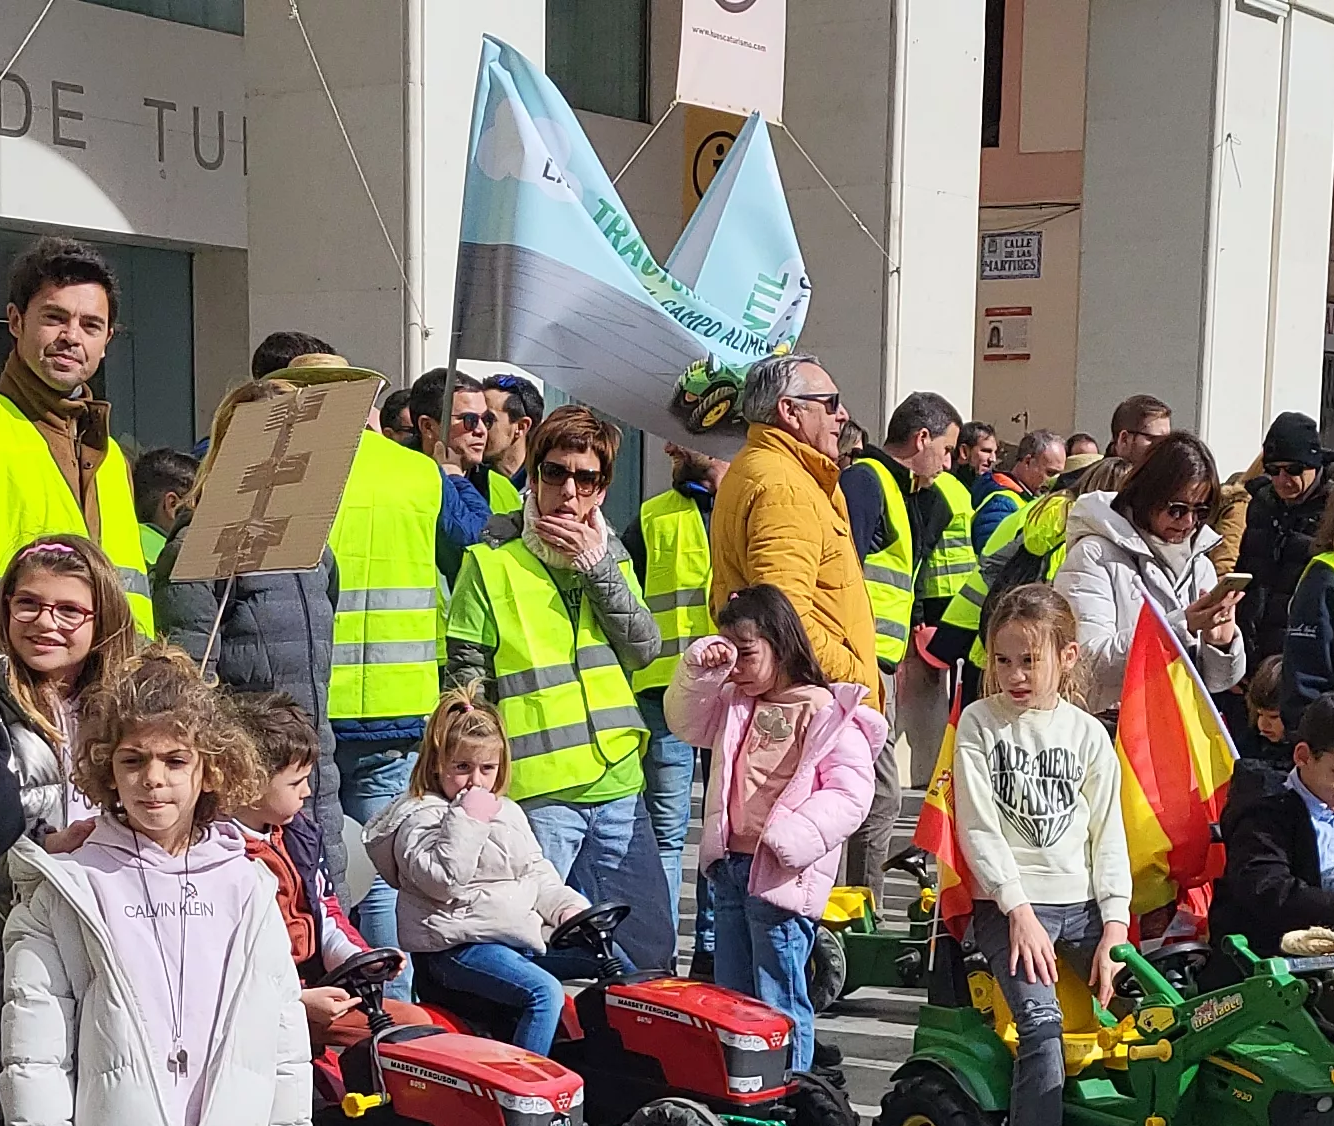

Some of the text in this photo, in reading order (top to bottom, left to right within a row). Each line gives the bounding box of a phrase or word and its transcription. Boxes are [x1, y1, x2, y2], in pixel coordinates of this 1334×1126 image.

[144, 96, 248, 177] TU
[1004, 238, 1033, 249] CALLE
[660, 299, 723, 338] CAMPO
[124, 901, 214, 918] CALVIN KLEIN
[618, 998, 679, 1019] MASSEY FERGUSON
[390, 1060, 458, 1086] MASSEY FERGUSON
